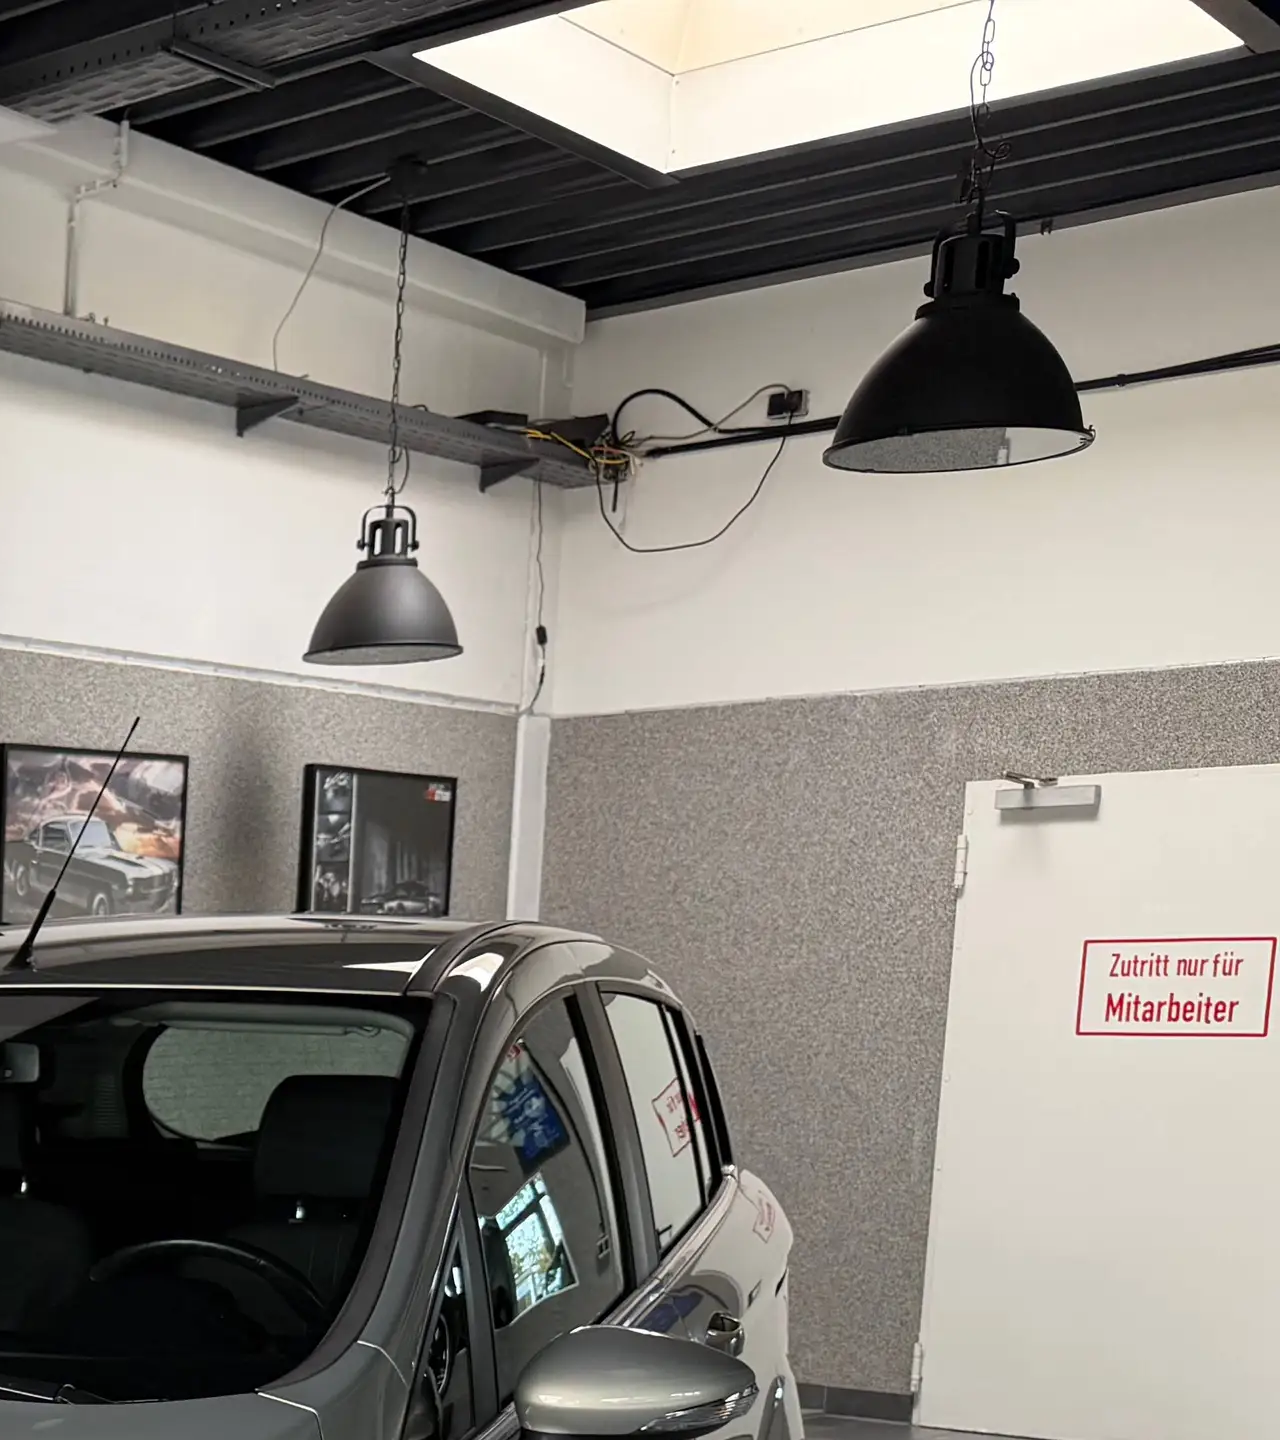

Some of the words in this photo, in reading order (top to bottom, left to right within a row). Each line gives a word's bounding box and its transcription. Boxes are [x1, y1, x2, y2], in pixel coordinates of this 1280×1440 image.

[1109, 953, 1170, 978] Zutritt
[1176, 958, 1209, 977] nur
[1212, 951, 1244, 978] für
[1104, 992, 1240, 1025] Mitarbeiter
